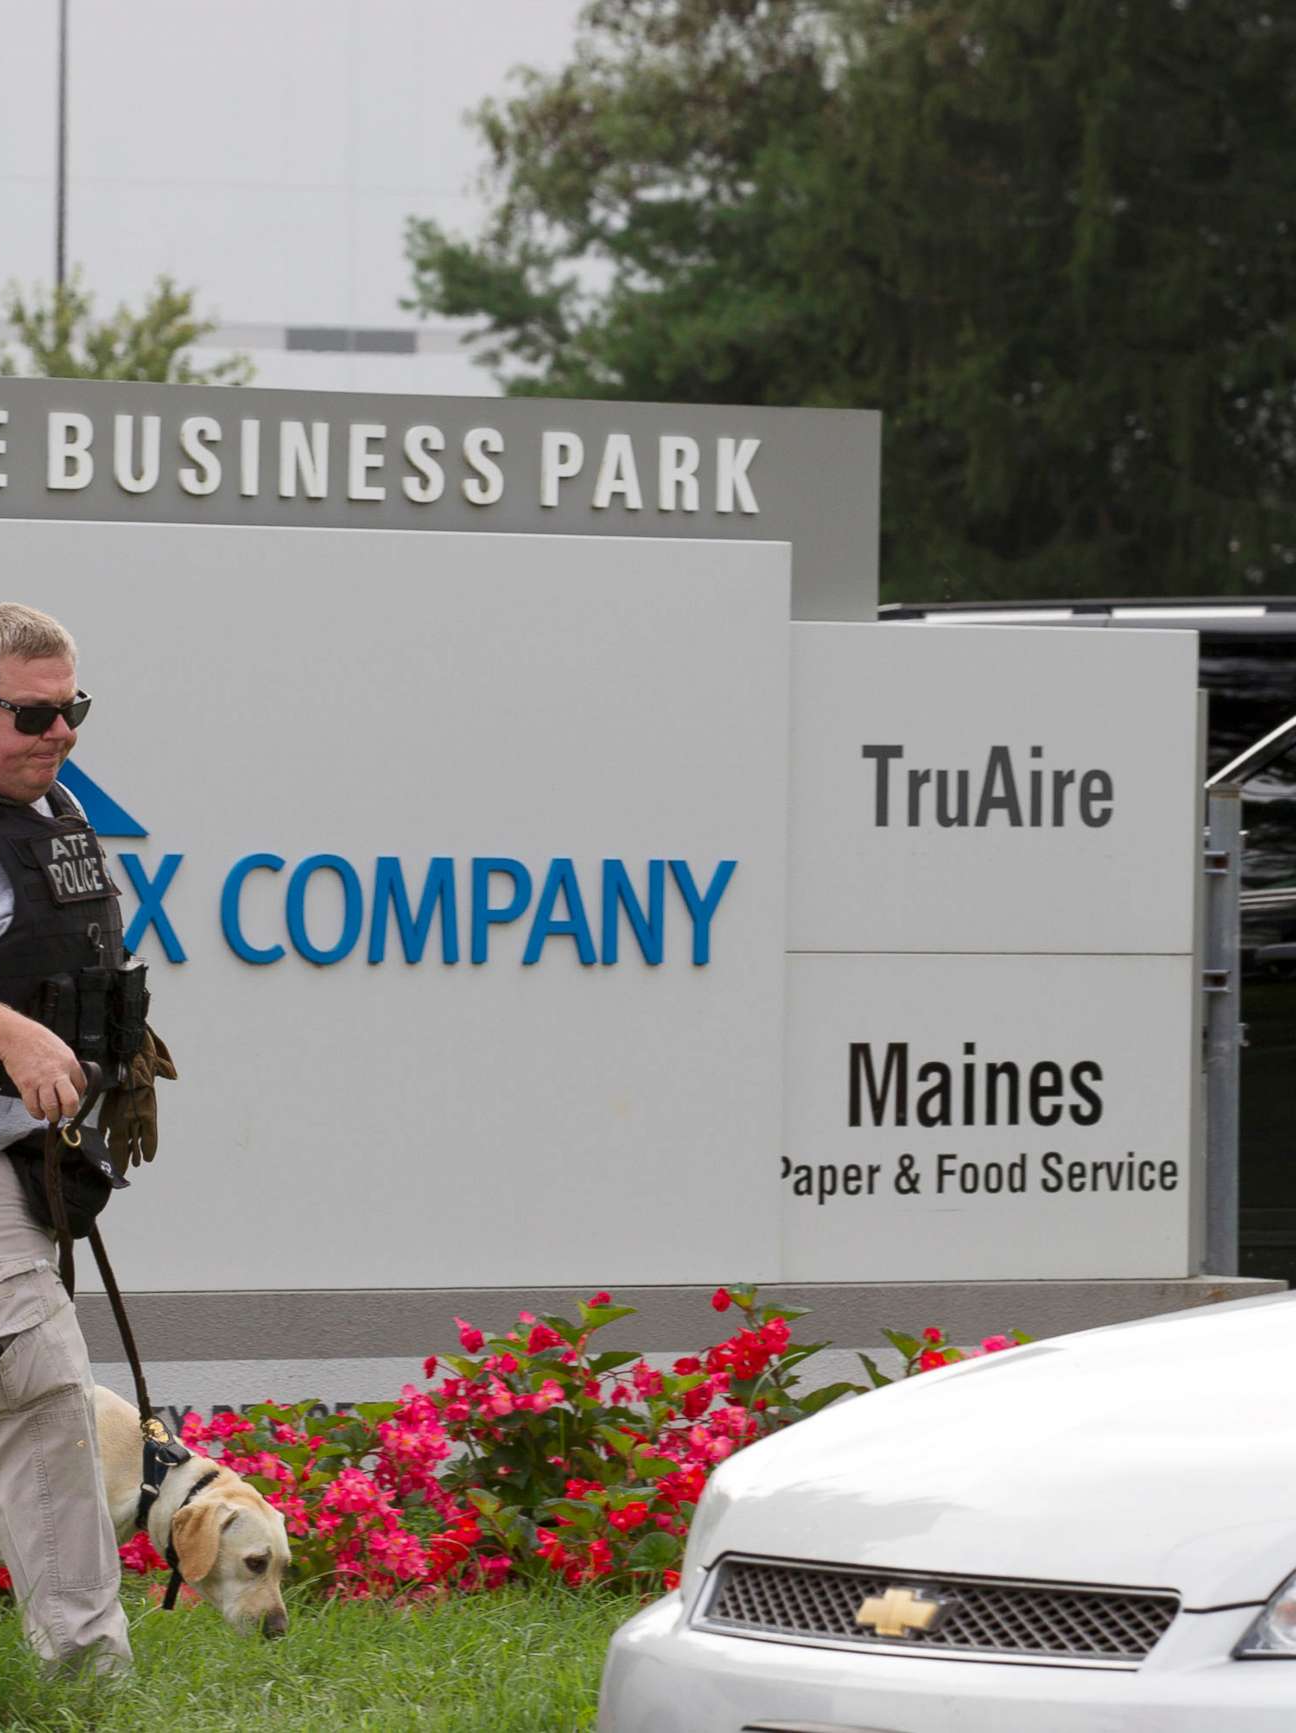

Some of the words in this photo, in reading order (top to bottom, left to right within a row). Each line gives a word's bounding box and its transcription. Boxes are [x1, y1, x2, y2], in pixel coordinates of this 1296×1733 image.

[46, 411, 506, 506] BUSINESS
[540, 430, 762, 514] PARK
[862, 744, 1115, 828] TruAire
[47, 857, 103, 896] POLICE
[50, 834, 90, 860] ATF
[220, 853, 738, 967] COMPANY
[848, 1041, 1104, 1128] Maines
[894, 1153, 921, 1195] &
[936, 1152, 1028, 1194] Food
[1041, 1151, 1179, 1193] Service
